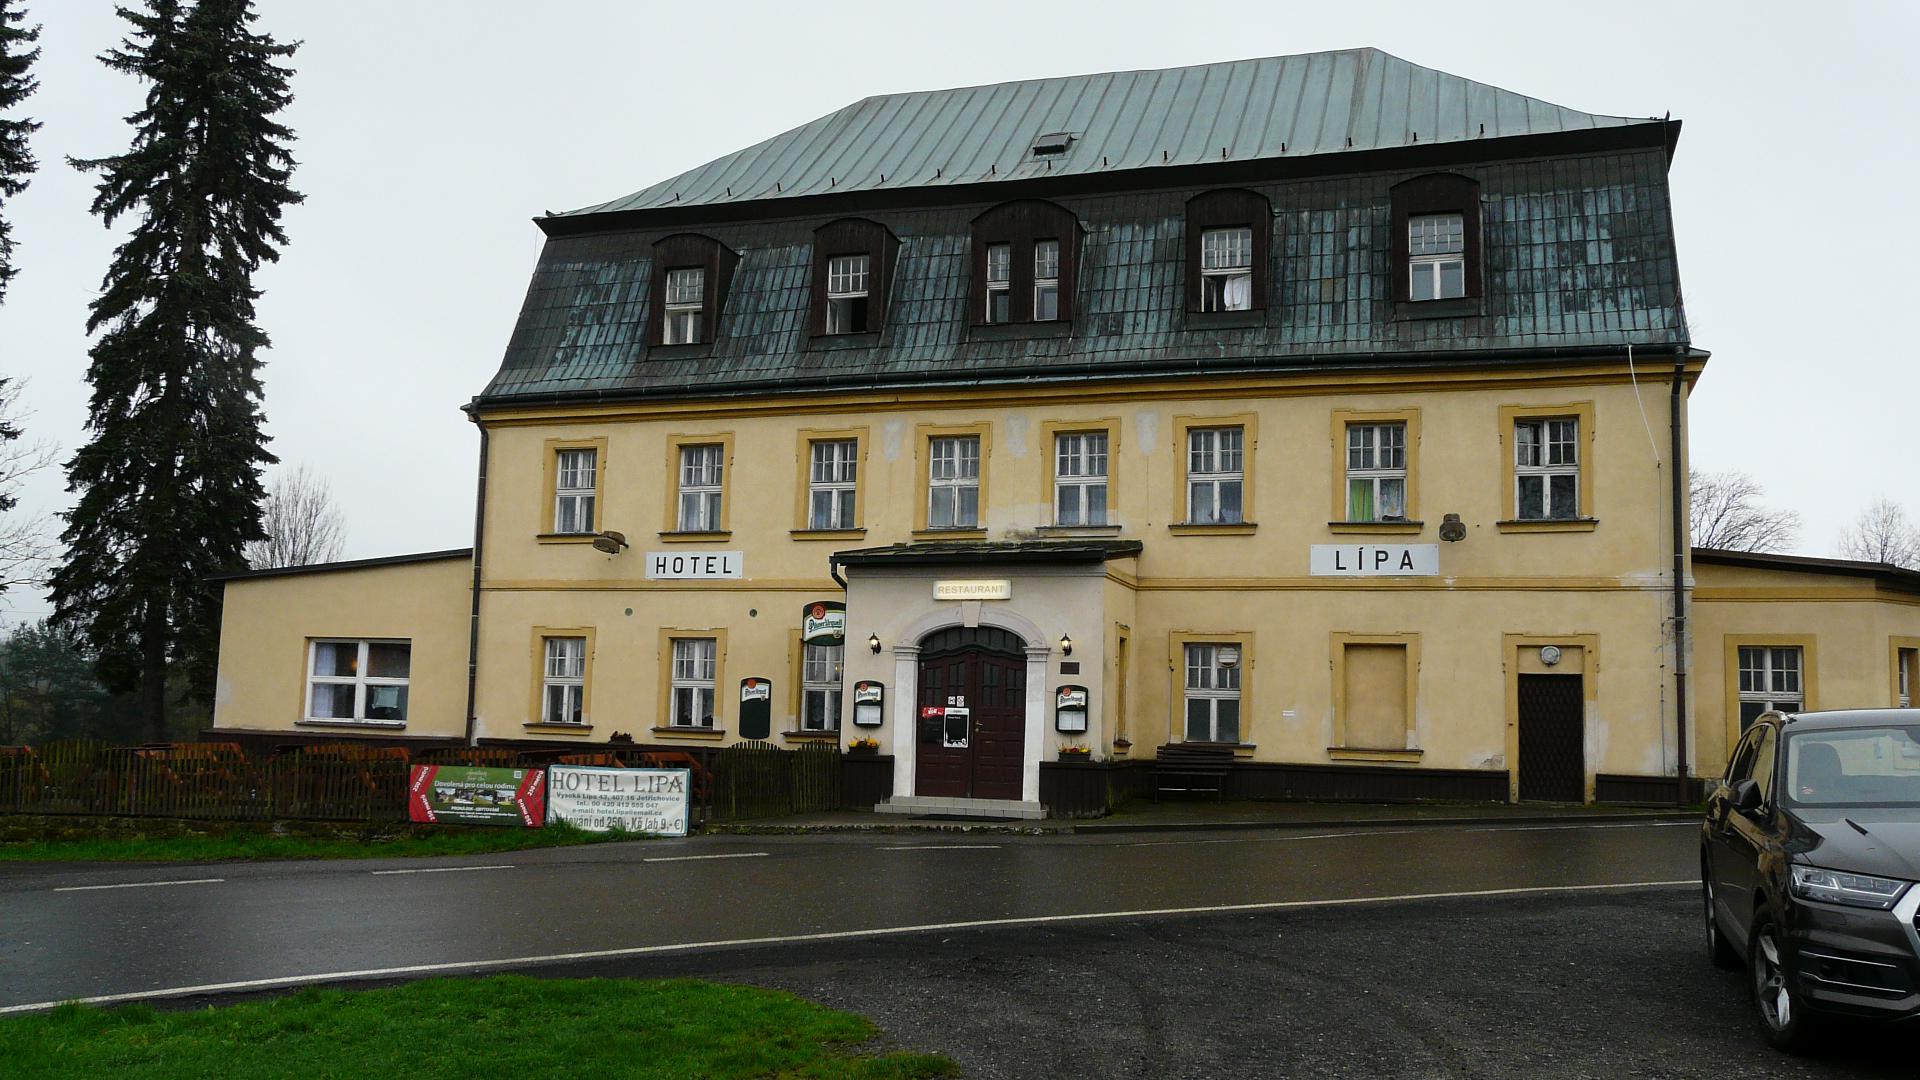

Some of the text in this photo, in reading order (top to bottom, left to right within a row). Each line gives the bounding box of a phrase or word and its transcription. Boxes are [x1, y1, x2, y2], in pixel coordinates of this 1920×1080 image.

[655, 556, 732, 575] HOTEL
[1335, 547, 1414, 571] LÍPA
[937, 585, 1005, 594] RESTAURANT
[552, 772, 684, 793] HOTEL LIPA
[595, 816, 605, 828] od
